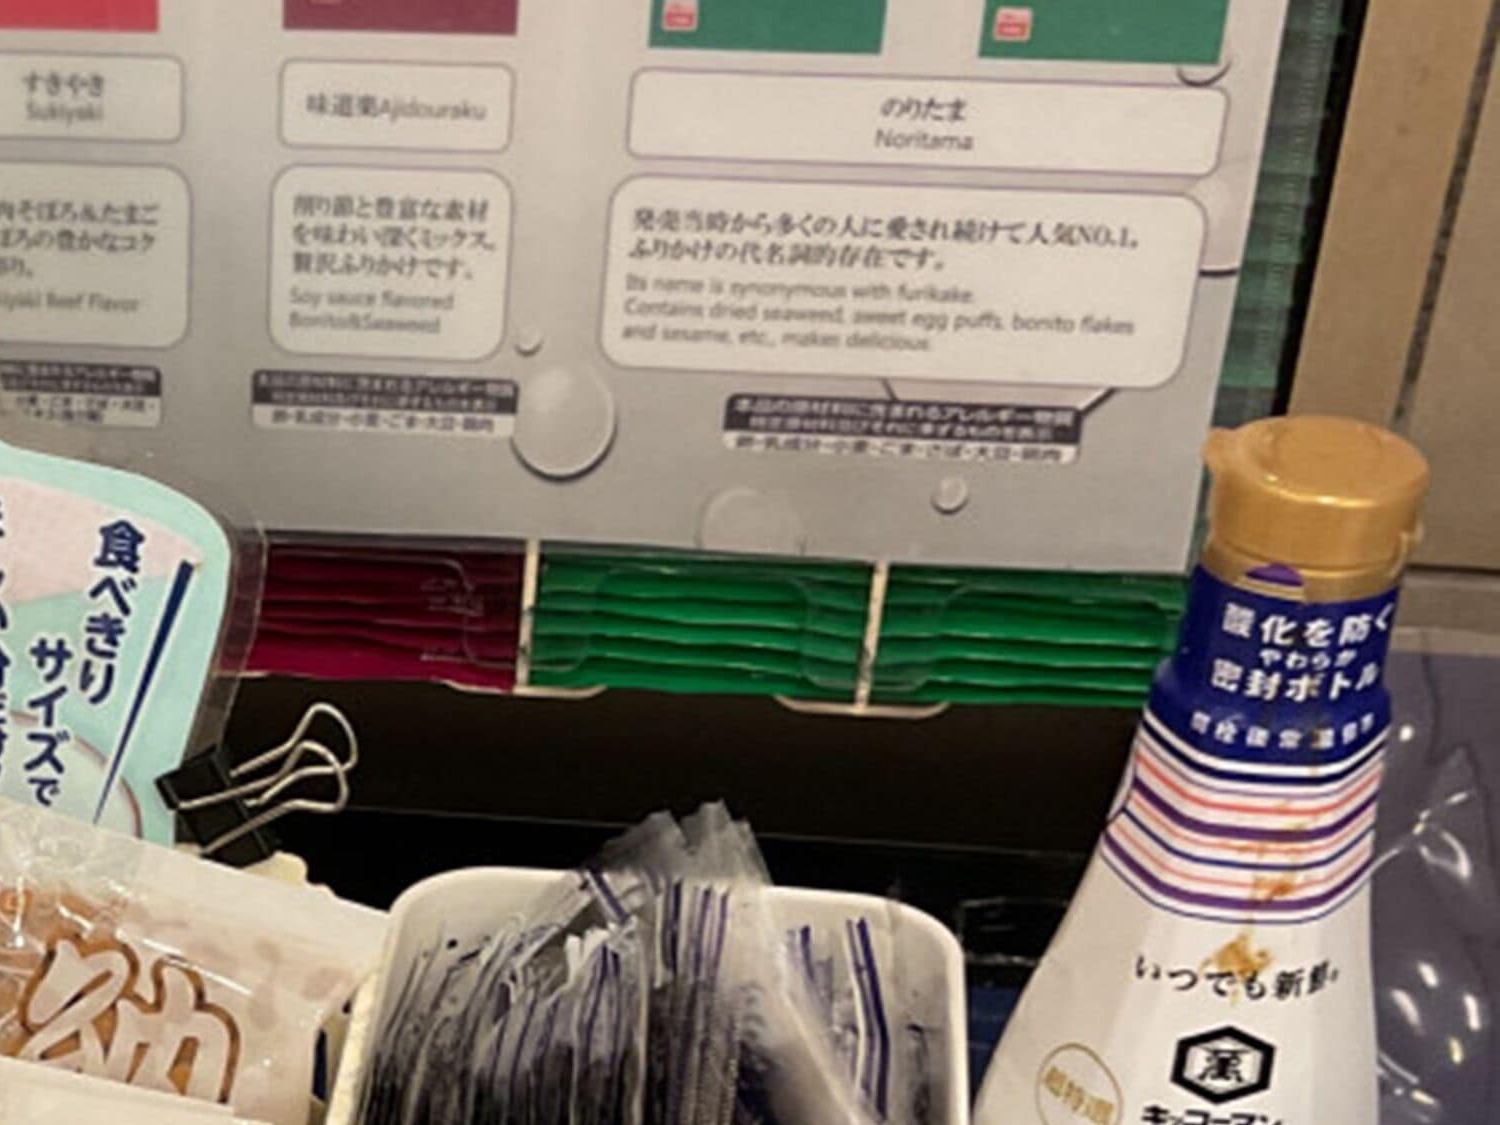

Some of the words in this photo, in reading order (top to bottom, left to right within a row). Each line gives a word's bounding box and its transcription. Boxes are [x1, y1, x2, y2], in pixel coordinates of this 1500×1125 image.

[23, 72, 104, 97] すきやき
[880, 97, 967, 123] のりたま
[874, 128, 974, 152] Noritama
[290, 287, 322, 308] Soy
[653, 277, 704, 293] name
[710, 278, 725, 294] is
[852, 284, 891, 299] with
[624, 298, 704, 318] Contains
[709, 303, 758, 320] dried
[852, 310, 906, 326] sweet
[911, 313, 949, 332] egg
[1012, 311, 1076, 333] bonito
[1080, 315, 1136, 334] flakes
[622, 324, 657, 340] and
[781, 330, 840, 347] makes
[79, 520, 145, 704] 食べきり
[1211, 657, 1380, 702] 密封ボトル
[24, 638, 74, 806] サイズで
